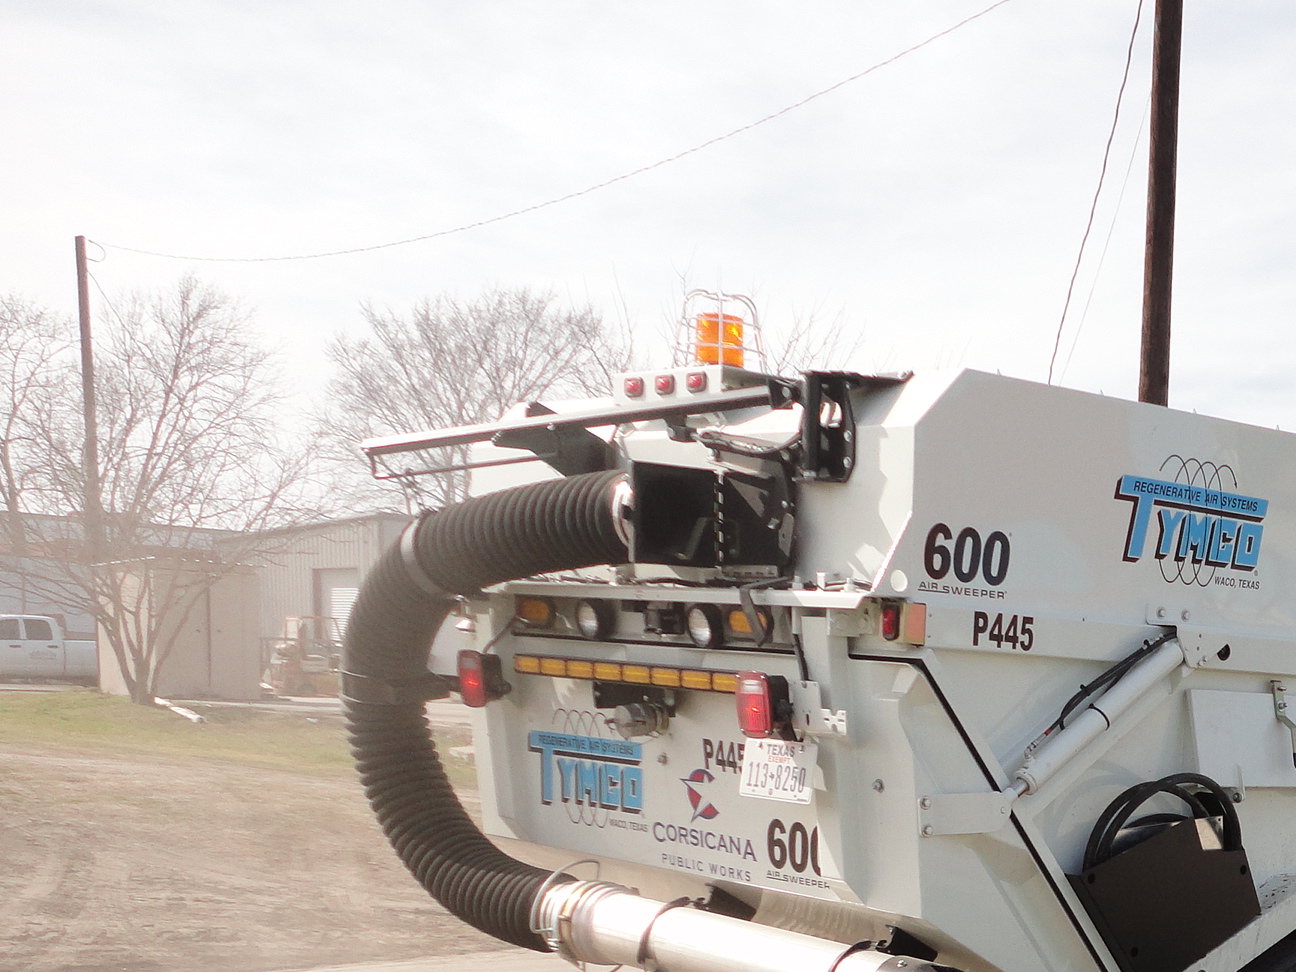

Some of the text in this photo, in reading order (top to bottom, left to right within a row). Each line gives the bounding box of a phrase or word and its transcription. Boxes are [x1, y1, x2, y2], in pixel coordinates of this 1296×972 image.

[1133, 480, 1258, 512] REGENERATIVE AIR SYSTEMS
[1114, 474, 1269, 572] TYMCO
[924, 522, 1011, 587] 600
[918, 581, 1005, 600] AIR SWEEPER
[1214, 576, 1260, 590] WACO, TEXAS
[972, 610, 1034, 652] P445
[766, 743, 795, 757] TEXAS
[768, 755, 791, 763] EXEMPT
[527, 730, 643, 815] TYMCO
[652, 821, 757, 862] CORSICANA
[661, 853, 752, 882] PUBLIC WORKS
[766, 870, 830, 890] AIR SWEEPER
